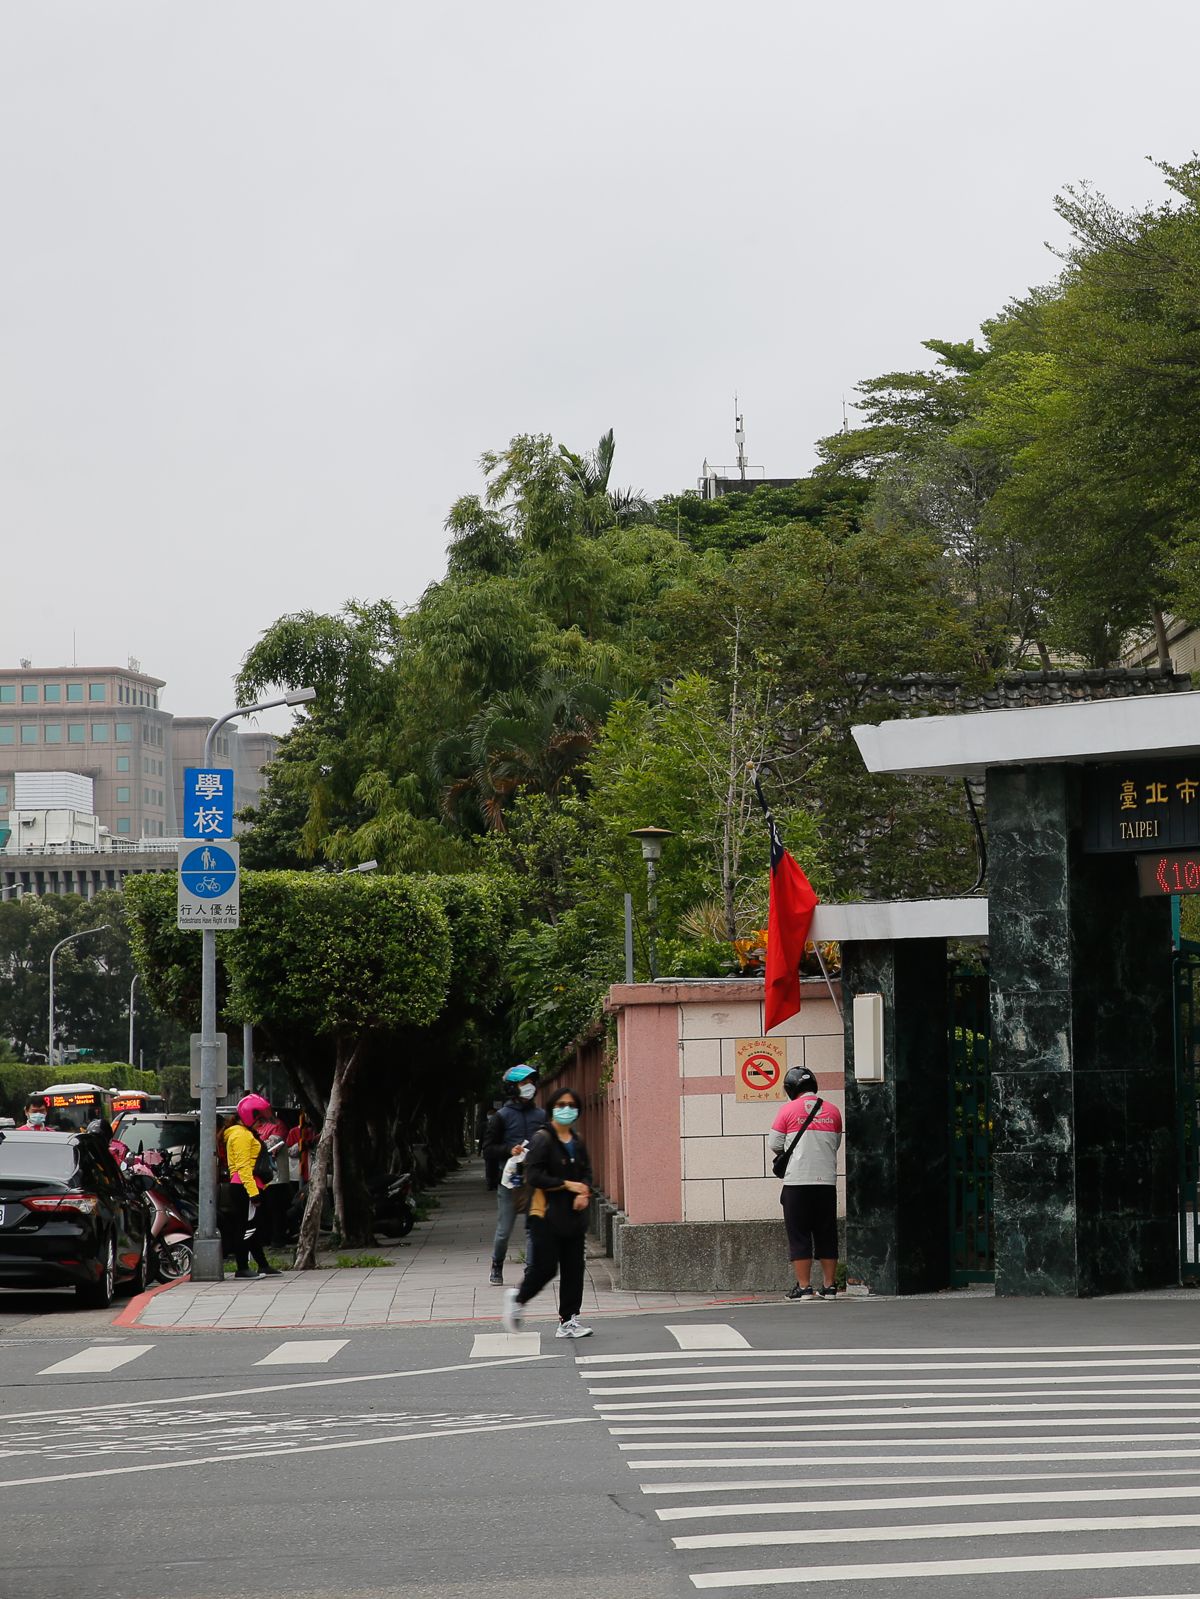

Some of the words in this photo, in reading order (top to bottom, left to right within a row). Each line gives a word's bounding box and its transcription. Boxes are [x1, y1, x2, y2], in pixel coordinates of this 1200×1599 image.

[193, 773, 224, 834] 學校
[1120, 820, 1158, 839] TAIPEI
[180, 903, 237, 916] 行人優先
[797, 1117, 834, 1125] fopanda
